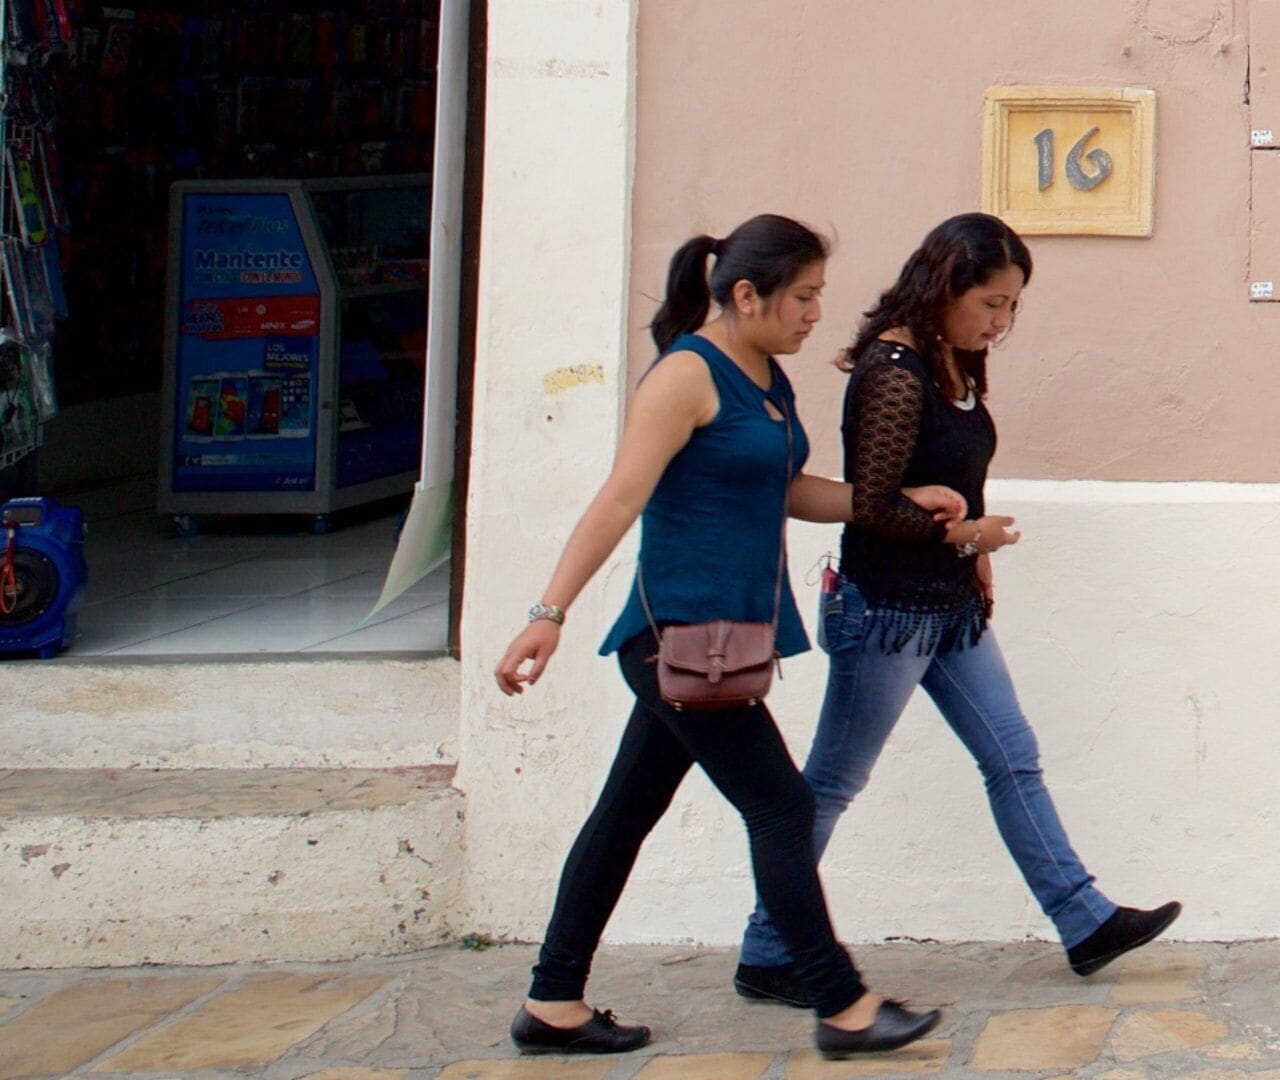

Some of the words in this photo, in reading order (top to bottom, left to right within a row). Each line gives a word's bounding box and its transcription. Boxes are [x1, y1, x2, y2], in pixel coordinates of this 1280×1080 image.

[1033, 125, 1113, 192] 16
[194, 251, 302, 268] Mantente
[266, 343, 285, 352] LOS
